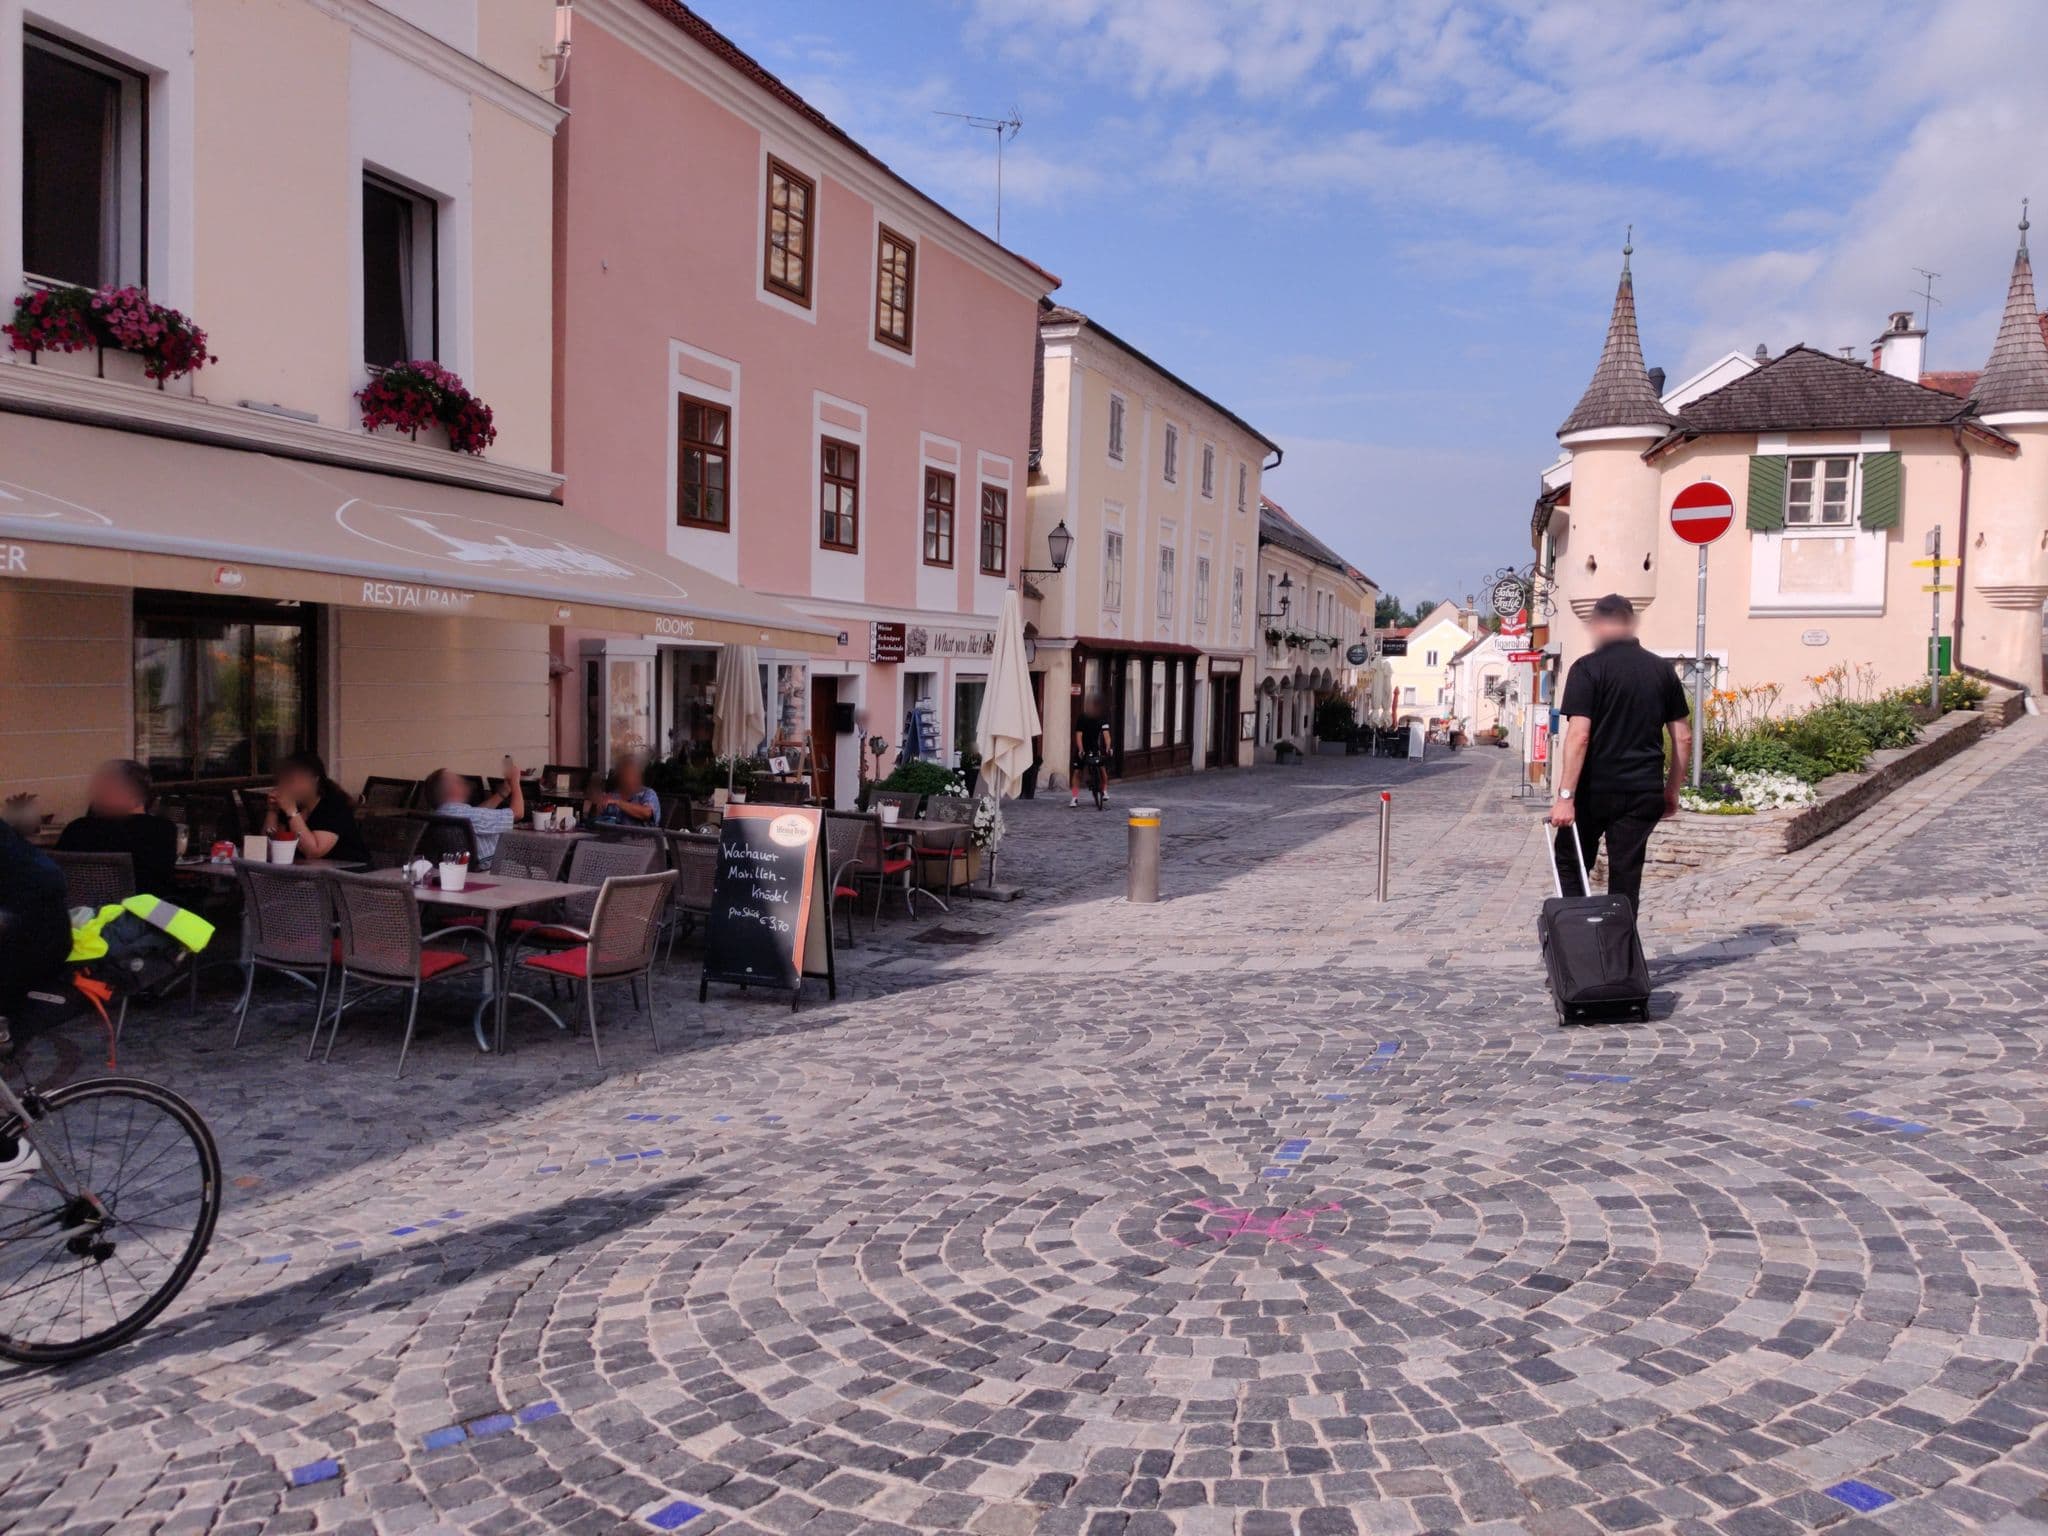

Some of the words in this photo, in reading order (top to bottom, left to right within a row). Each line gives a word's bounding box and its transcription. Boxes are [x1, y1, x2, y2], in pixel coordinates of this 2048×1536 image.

[655, 616, 695, 637] ROOMS
[934, 632, 955, 652] What
[954, 639, 968, 657] you
[722, 842, 779, 862] Wachauer
